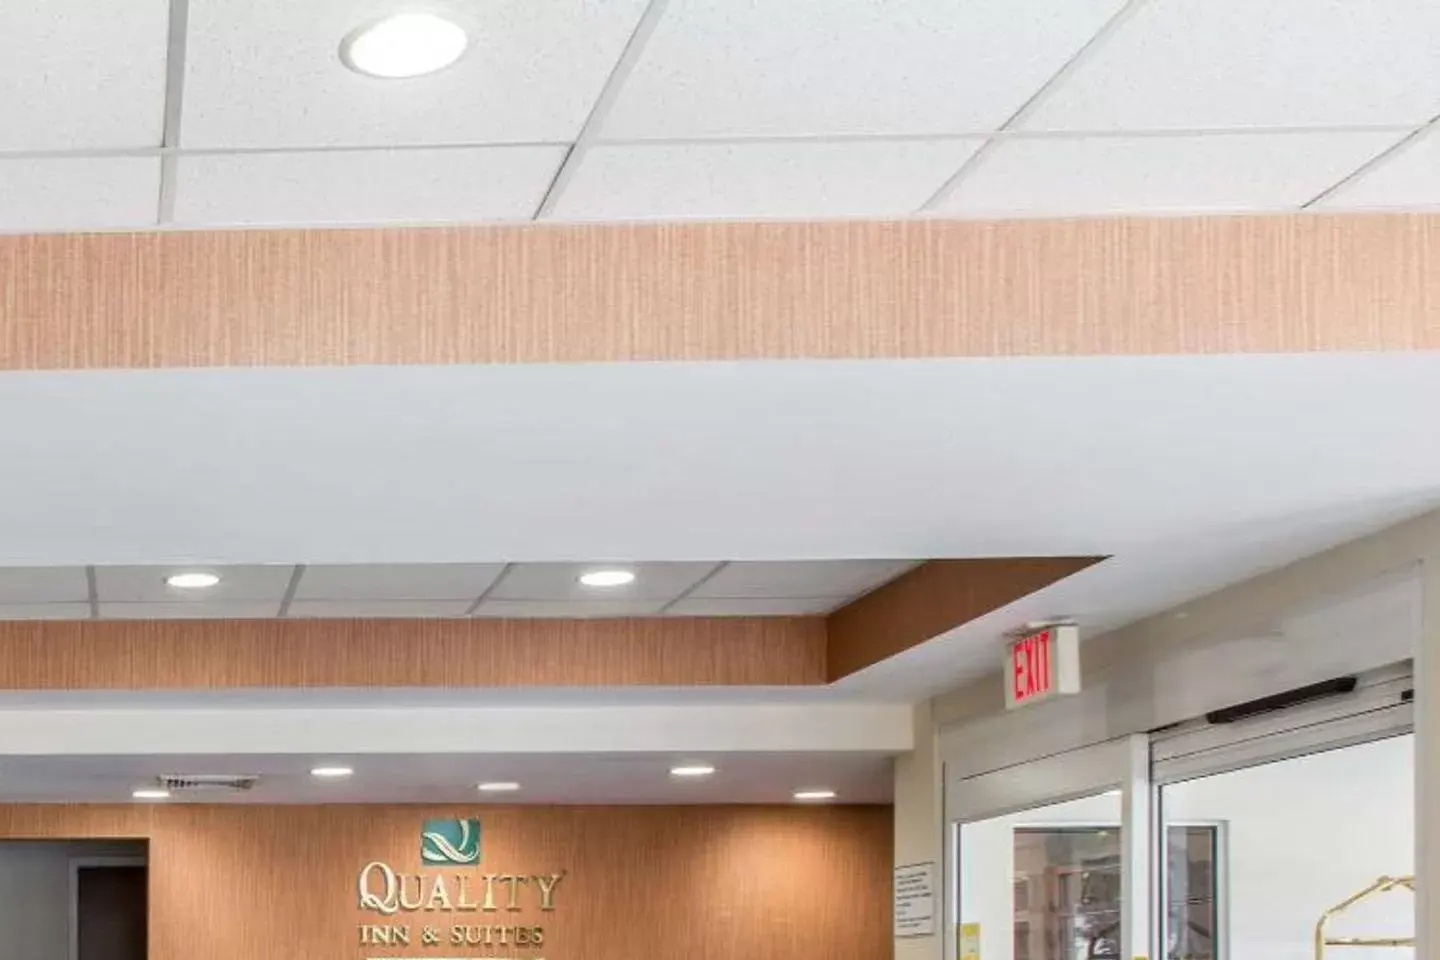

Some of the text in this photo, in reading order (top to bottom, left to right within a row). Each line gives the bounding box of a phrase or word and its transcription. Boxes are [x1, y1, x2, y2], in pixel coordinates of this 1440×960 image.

[1013, 631, 1050, 702] EXIT
[358, 861, 561, 914] QUALITY
[358, 924, 544, 945] INN & SUITES
